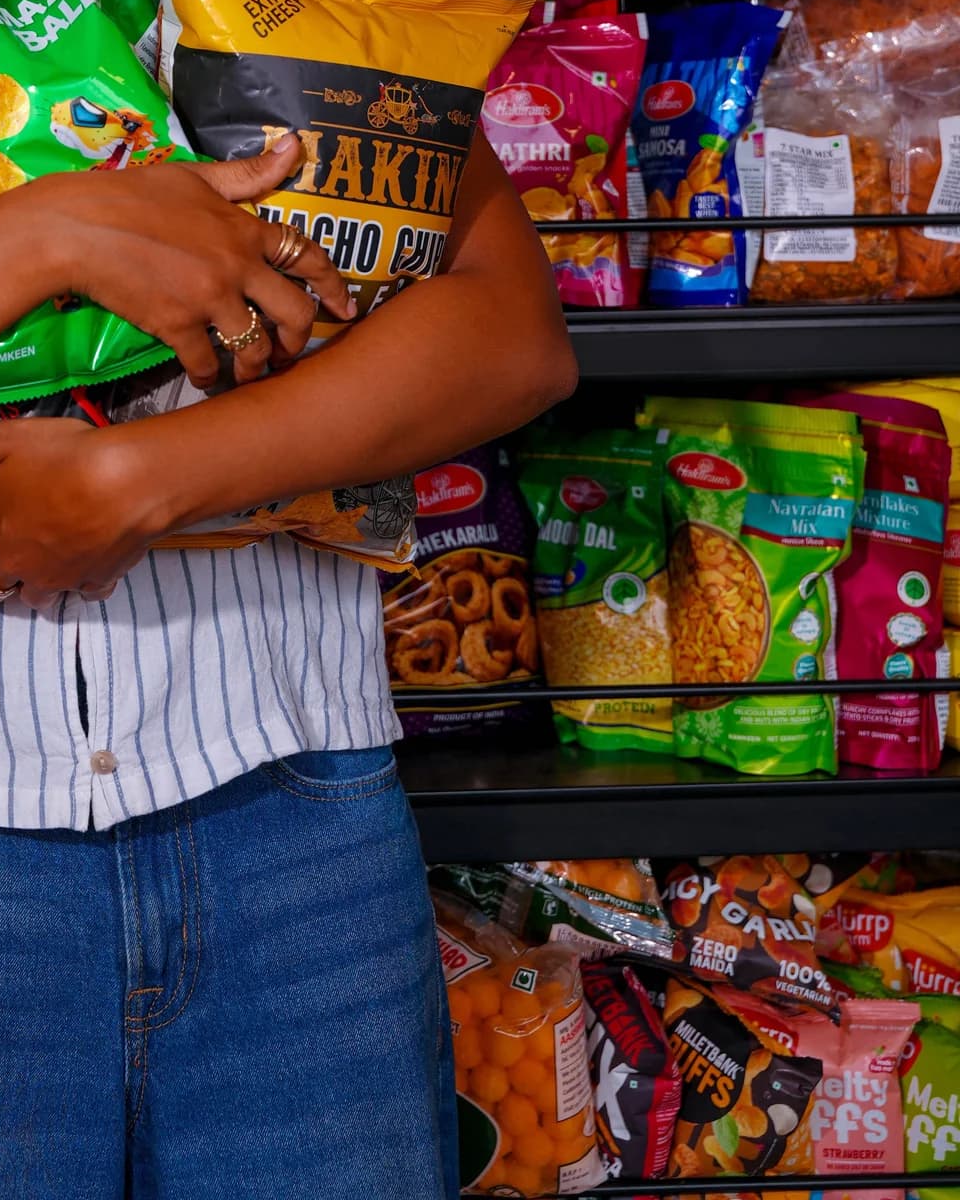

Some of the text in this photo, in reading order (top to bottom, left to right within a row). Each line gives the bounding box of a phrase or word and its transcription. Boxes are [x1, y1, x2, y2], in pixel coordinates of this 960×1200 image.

[678, 466, 731, 487] Haldiram's
[416, 483, 475, 507] Haldiram's
[768, 498, 845, 519] Navratan
[584, 523, 617, 550] DAL
[791, 519, 817, 536] Mix
[693, 937, 737, 962] ZERO
[690, 956, 734, 976] MAIDA
[778, 960, 831, 991] 100%
[775, 981, 831, 1006] VEGETARIAN
[675, 1020, 744, 1079] MILLETBANK
